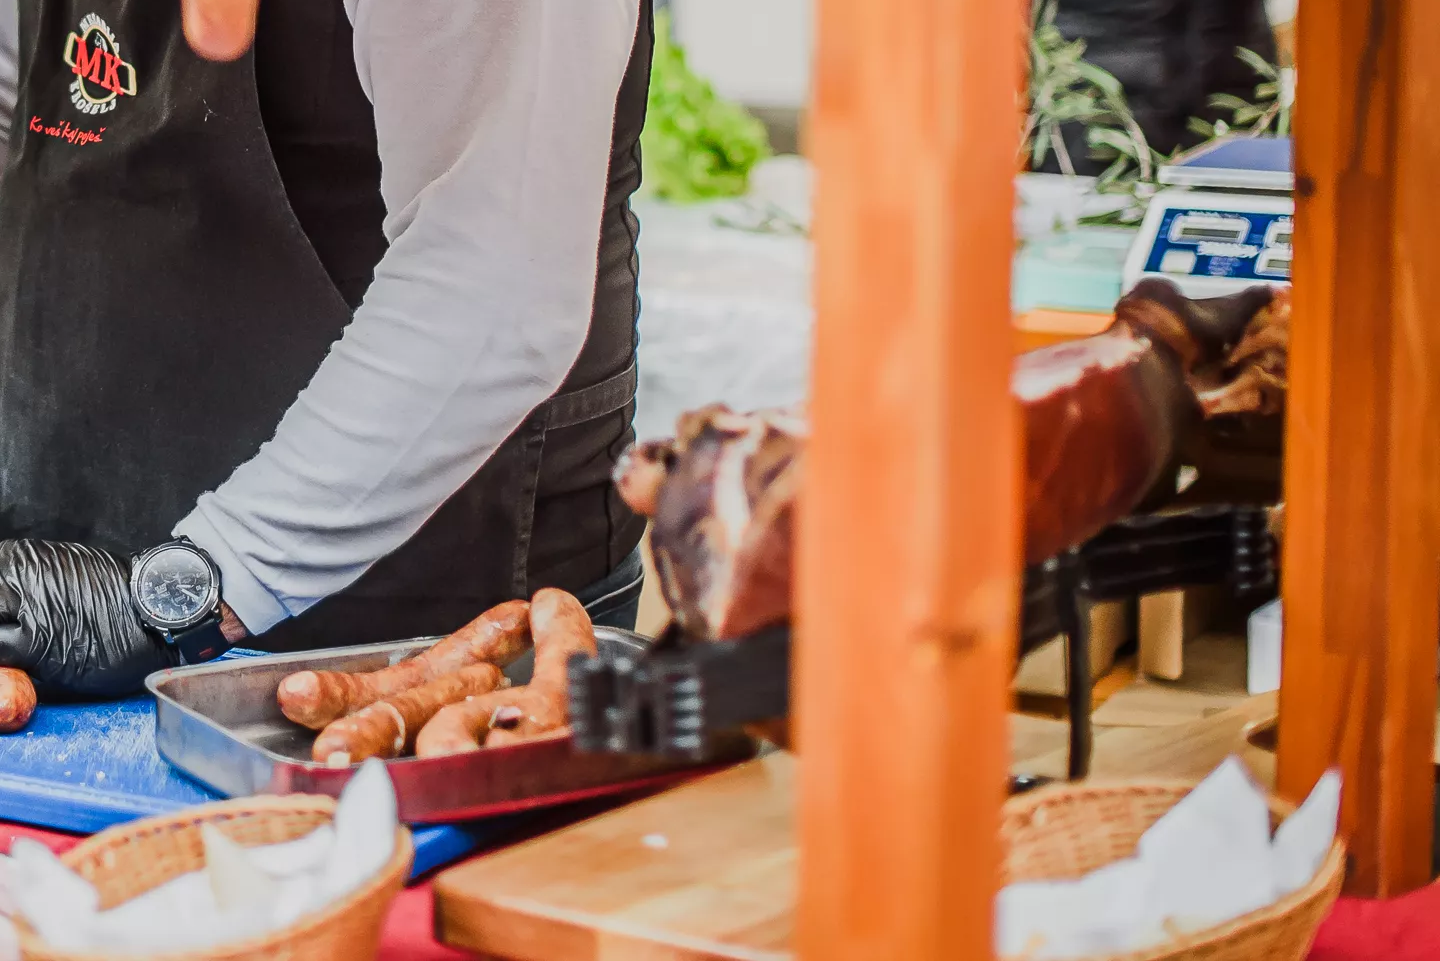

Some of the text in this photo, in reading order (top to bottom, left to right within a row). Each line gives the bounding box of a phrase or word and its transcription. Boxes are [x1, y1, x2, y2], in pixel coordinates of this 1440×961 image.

[71, 37, 125, 96] MK
[30, 115, 107, 146] Ko veš kaj poješ
